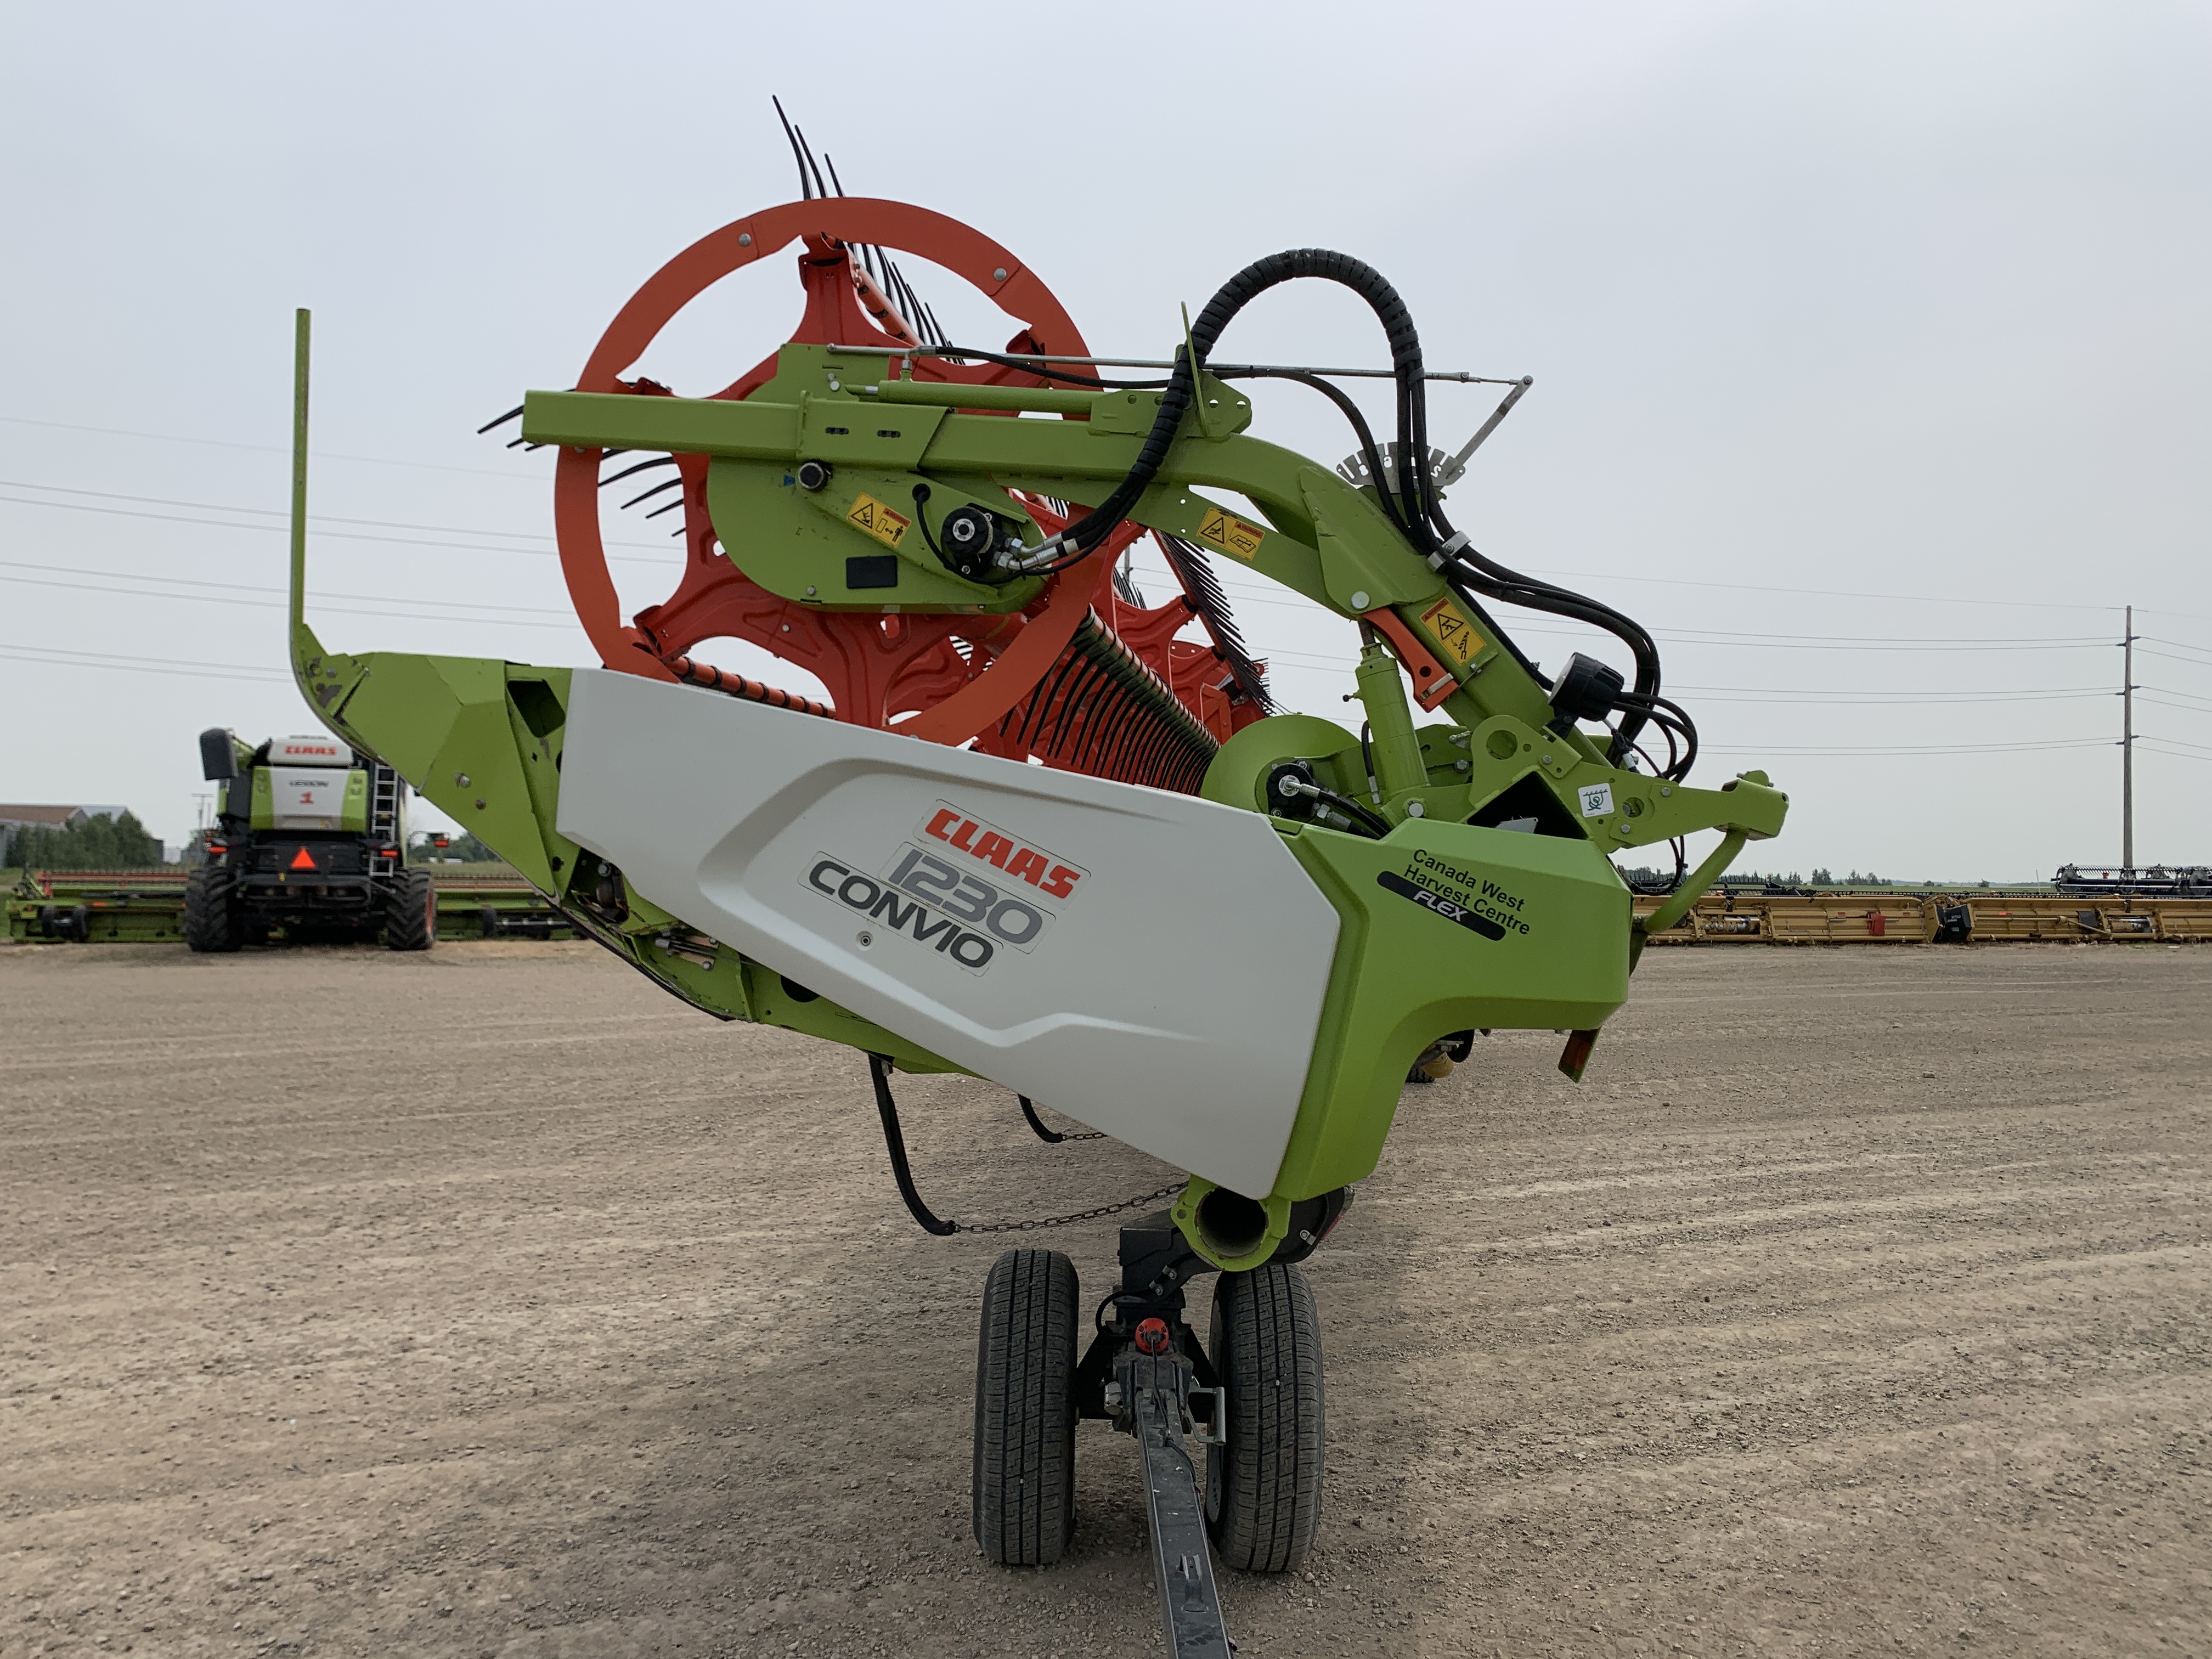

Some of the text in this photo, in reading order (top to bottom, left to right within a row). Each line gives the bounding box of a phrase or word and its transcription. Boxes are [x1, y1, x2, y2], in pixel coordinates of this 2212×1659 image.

[285, 746, 337, 756] CLAAS
[299, 791, 314, 805] 1
[925, 808, 1081, 899] CLAAS
[1413, 849, 1525, 912] Canada West
[809, 860, 994, 968] CONVIO
[888, 848, 1042, 944] 1230
[1403, 864, 1530, 935] Harvest Centre
[1413, 890, 1468, 922] FLEX
